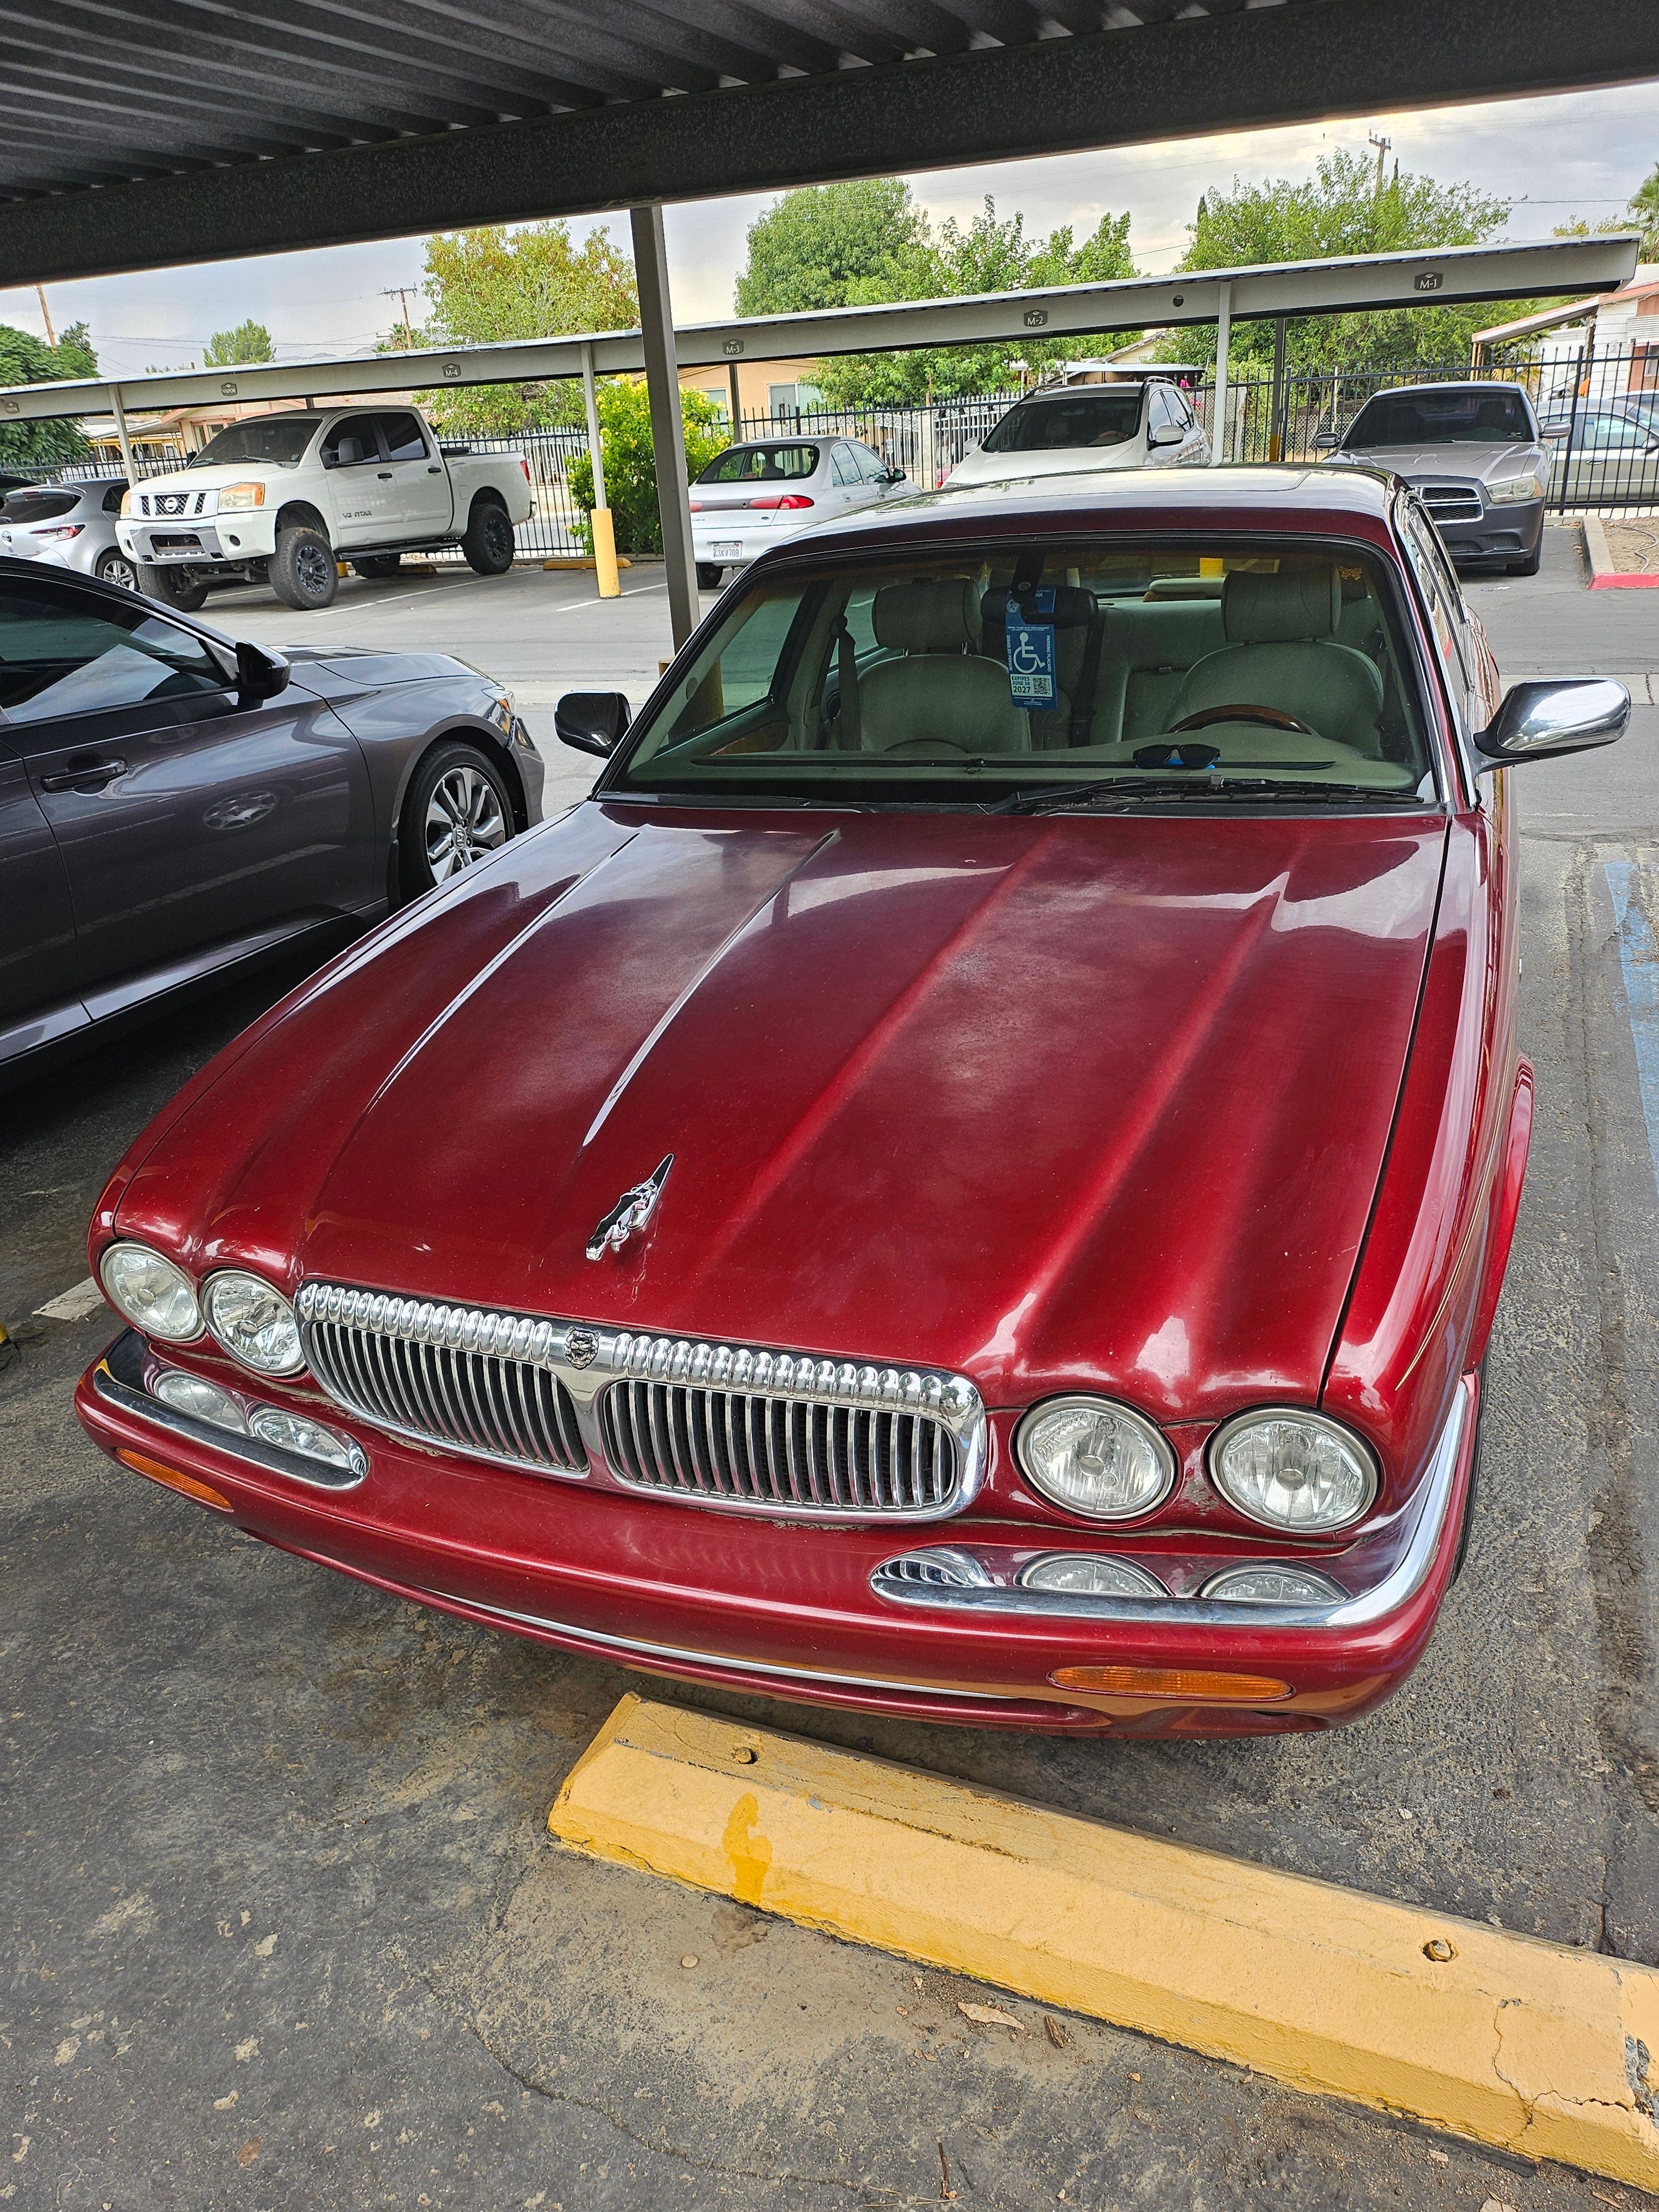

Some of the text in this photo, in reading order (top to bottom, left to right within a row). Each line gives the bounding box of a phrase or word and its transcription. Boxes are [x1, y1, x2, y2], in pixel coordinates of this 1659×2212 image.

[1419, 278, 1437, 289] M-1
[1027, 316, 1043, 325] M-2
[726, 345, 739, 354] M-3
